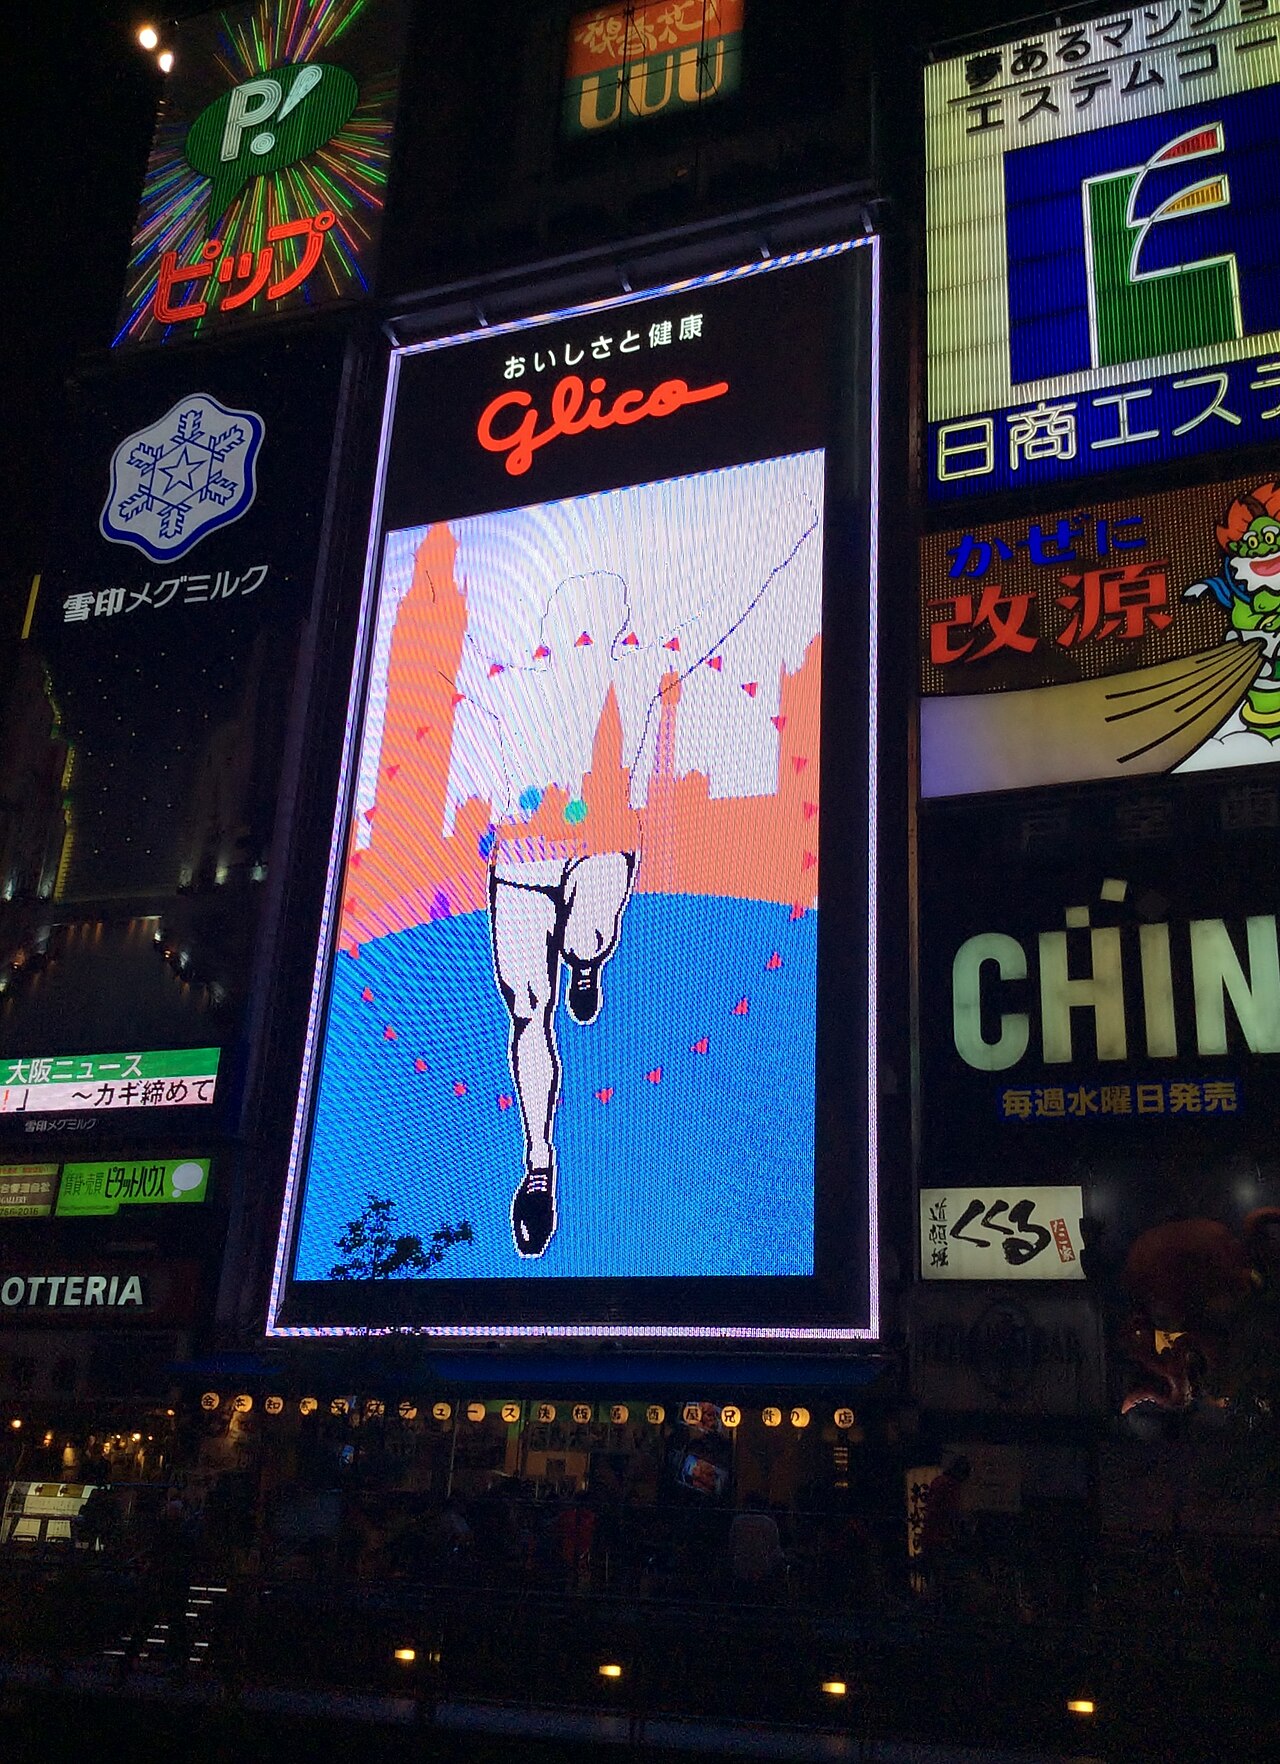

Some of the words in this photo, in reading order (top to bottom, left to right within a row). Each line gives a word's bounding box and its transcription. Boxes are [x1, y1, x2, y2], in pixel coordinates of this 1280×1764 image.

[153, 211, 335, 324] ピップ
[503, 313, 704, 380] おいしさと健康
[947, 513, 1147, 579] かぜに
[62, 565, 269, 624] 雪印メグミルク
[928, 558, 1174, 664] 改源
[5, 1053, 144, 1085] 大阪ニュース
[1002, 1082, 1238, 1118] 毎週水曜日発売
[24, 1118, 97, 1133] 雪印メグミルク
[950, 1199, 1052, 1266] くくる
[1, 1275, 143, 1306] OTTERIA
